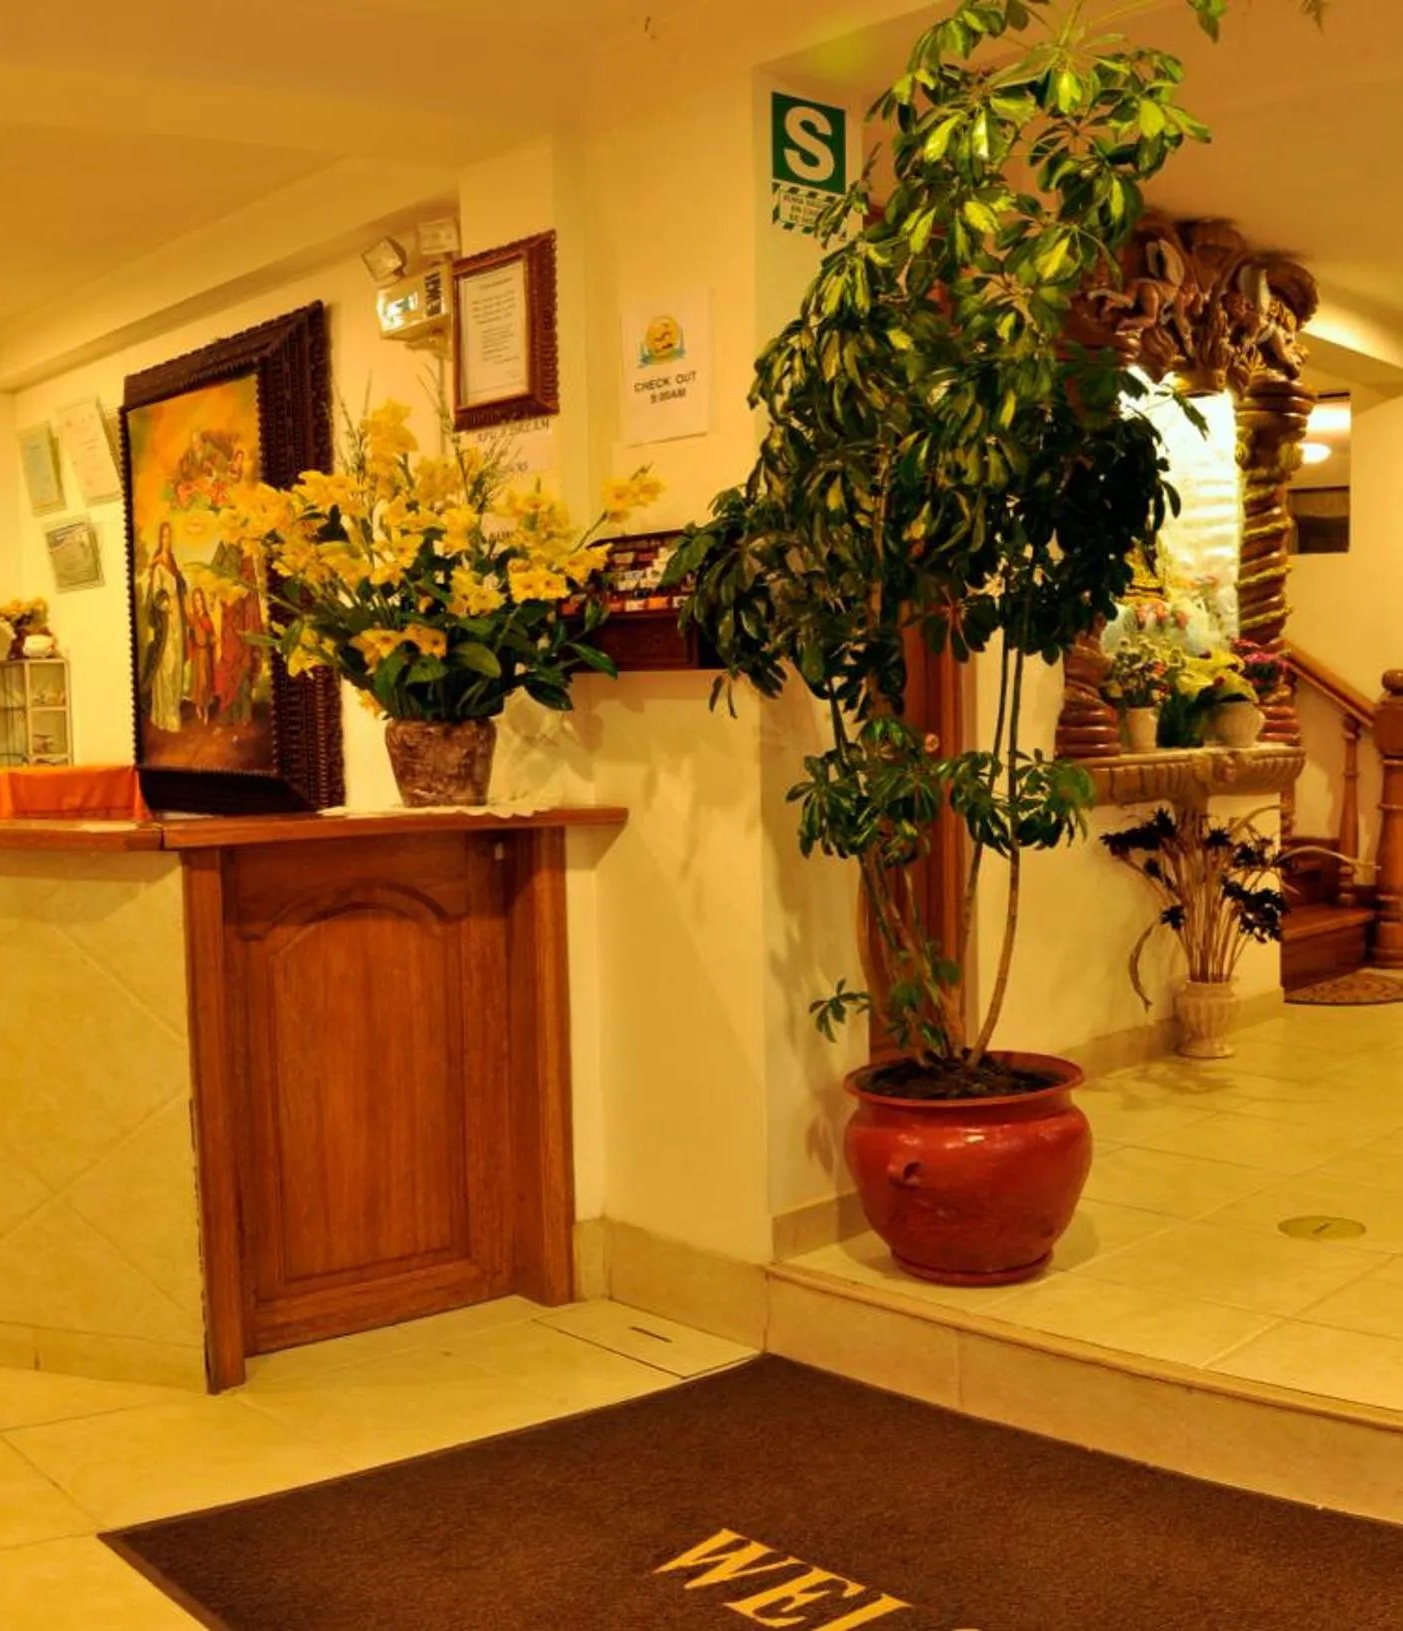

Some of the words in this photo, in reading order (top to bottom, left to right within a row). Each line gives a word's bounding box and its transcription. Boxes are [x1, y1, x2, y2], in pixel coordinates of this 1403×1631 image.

[783, 106, 835, 182] S
[634, 376, 671, 393] CHECK
[675, 370, 697, 386] OUT
